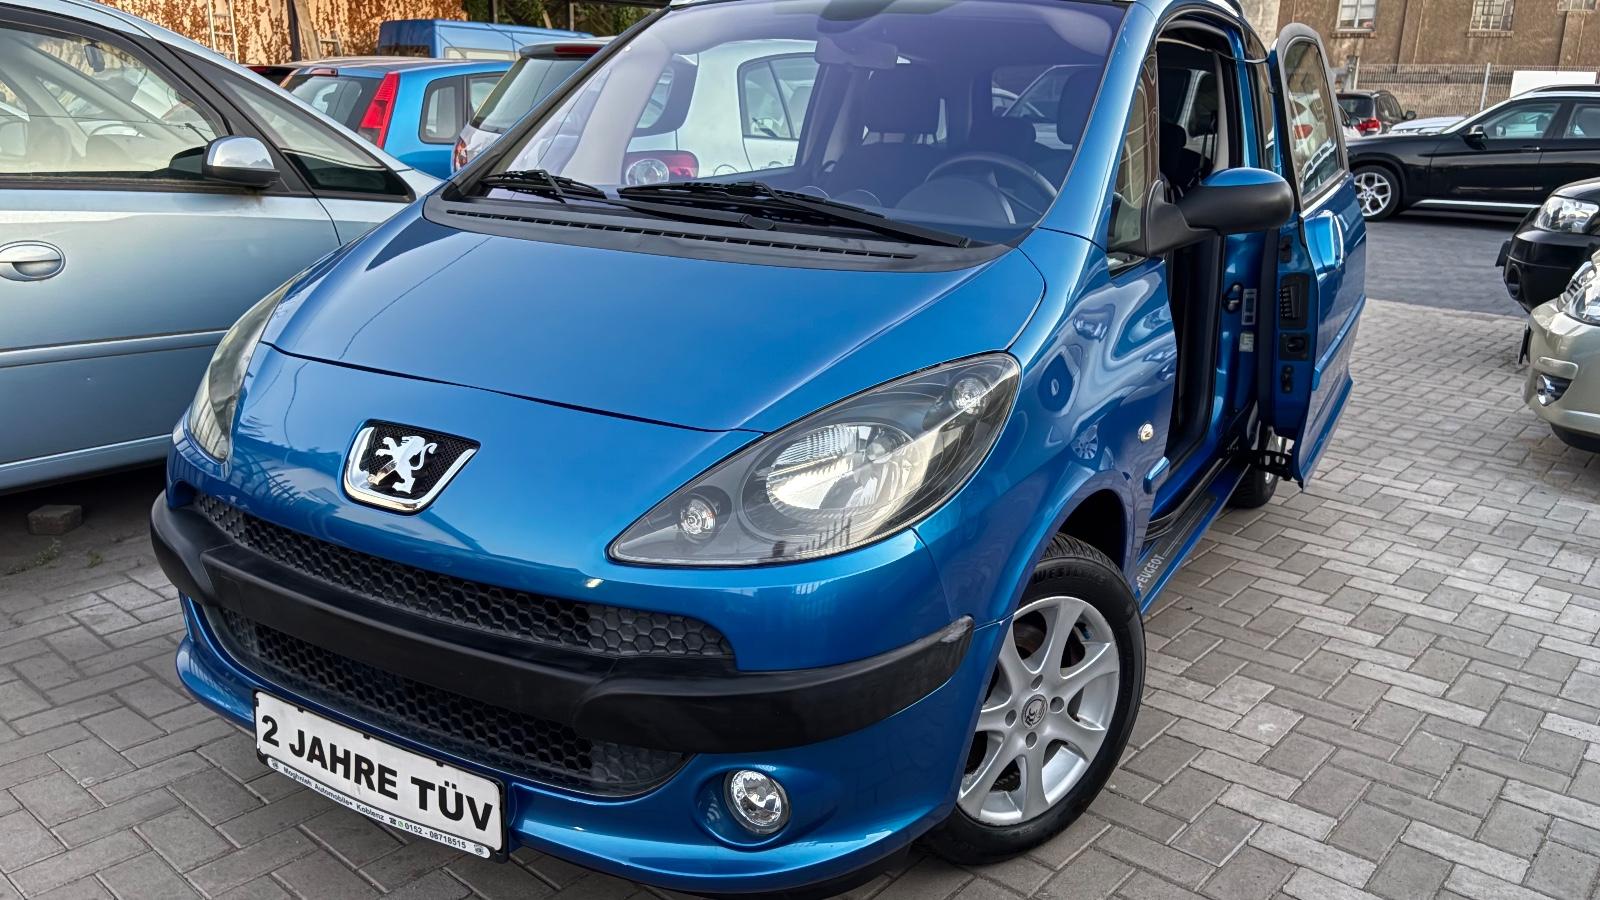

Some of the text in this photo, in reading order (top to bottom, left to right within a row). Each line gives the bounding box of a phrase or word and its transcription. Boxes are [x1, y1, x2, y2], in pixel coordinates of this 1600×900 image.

[261, 715, 493, 831] 2 JAHRE TÜV
[356, 803, 385, 820] Koblenz
[404, 823, 423, 835] 0152
[429, 832, 467, 849] 08718515
